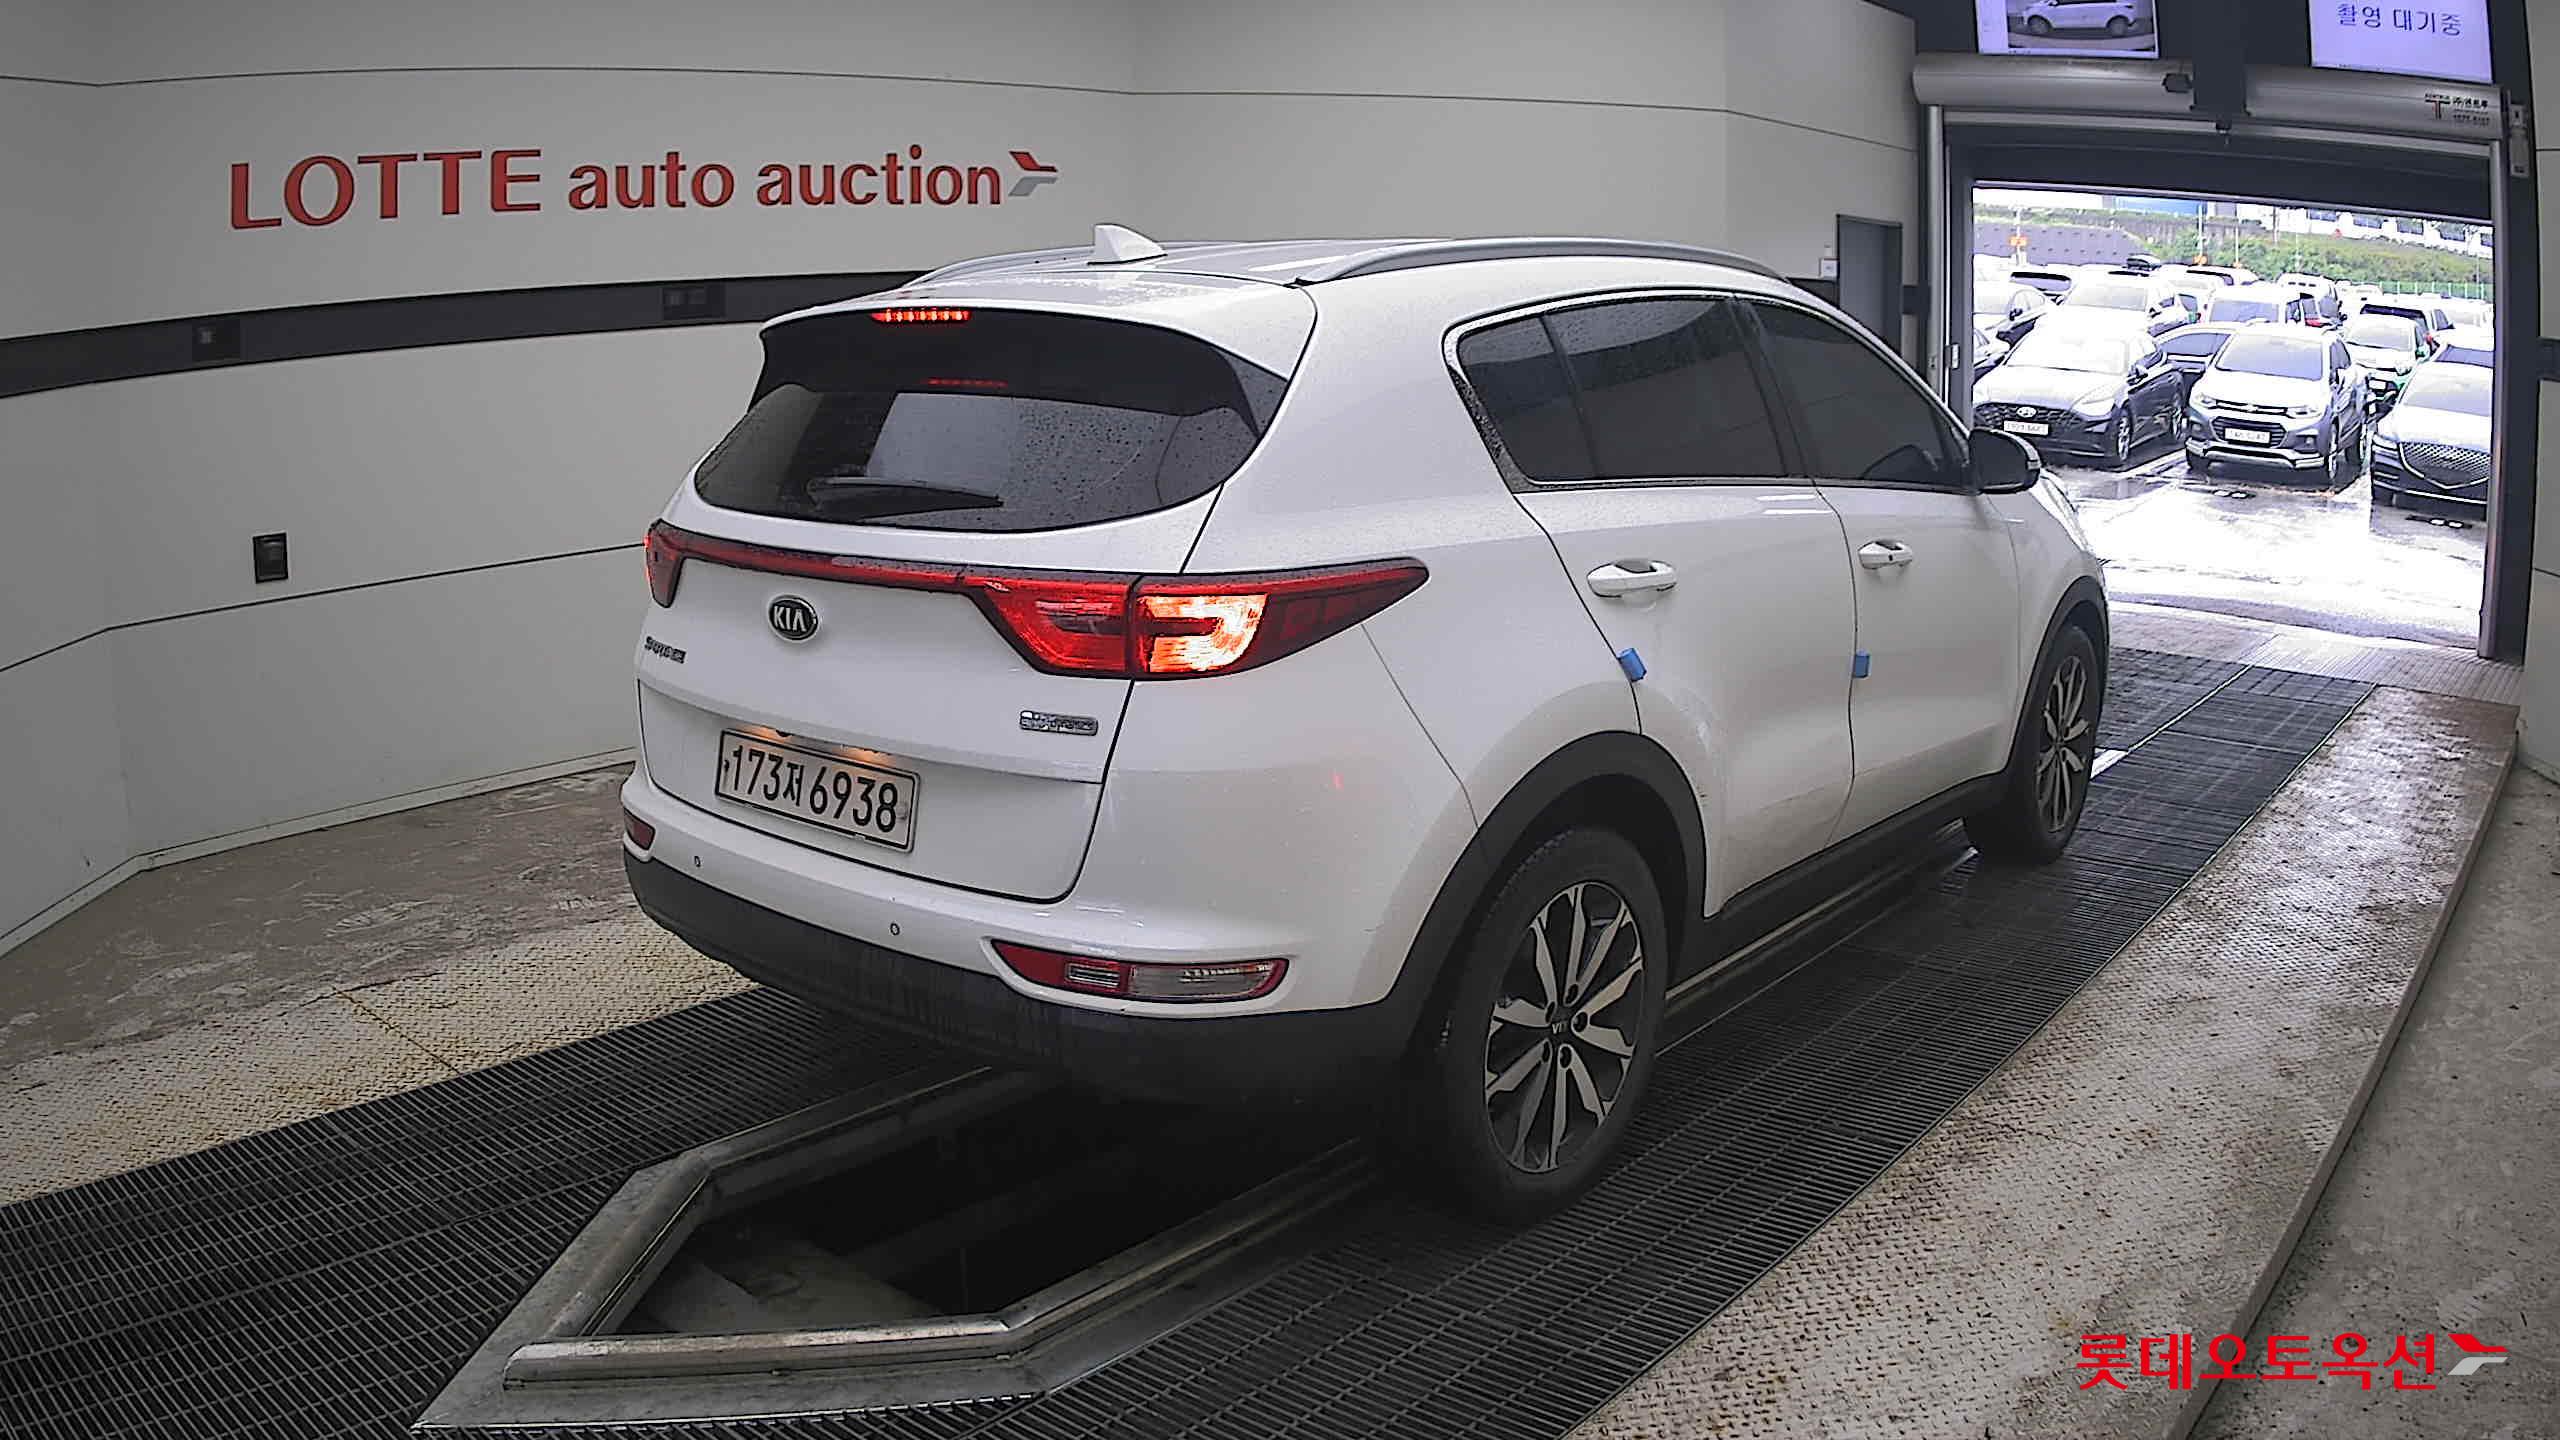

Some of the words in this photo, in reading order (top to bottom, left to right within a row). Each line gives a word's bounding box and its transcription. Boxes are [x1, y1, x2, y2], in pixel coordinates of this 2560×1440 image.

[2392, 9, 2462, 36] 대기중
[231, 149, 542, 230] LOTTE
[568, 150, 735, 209] auto
[757, 145, 1001, 207] auction
[774, 606, 807, 632] KIA
